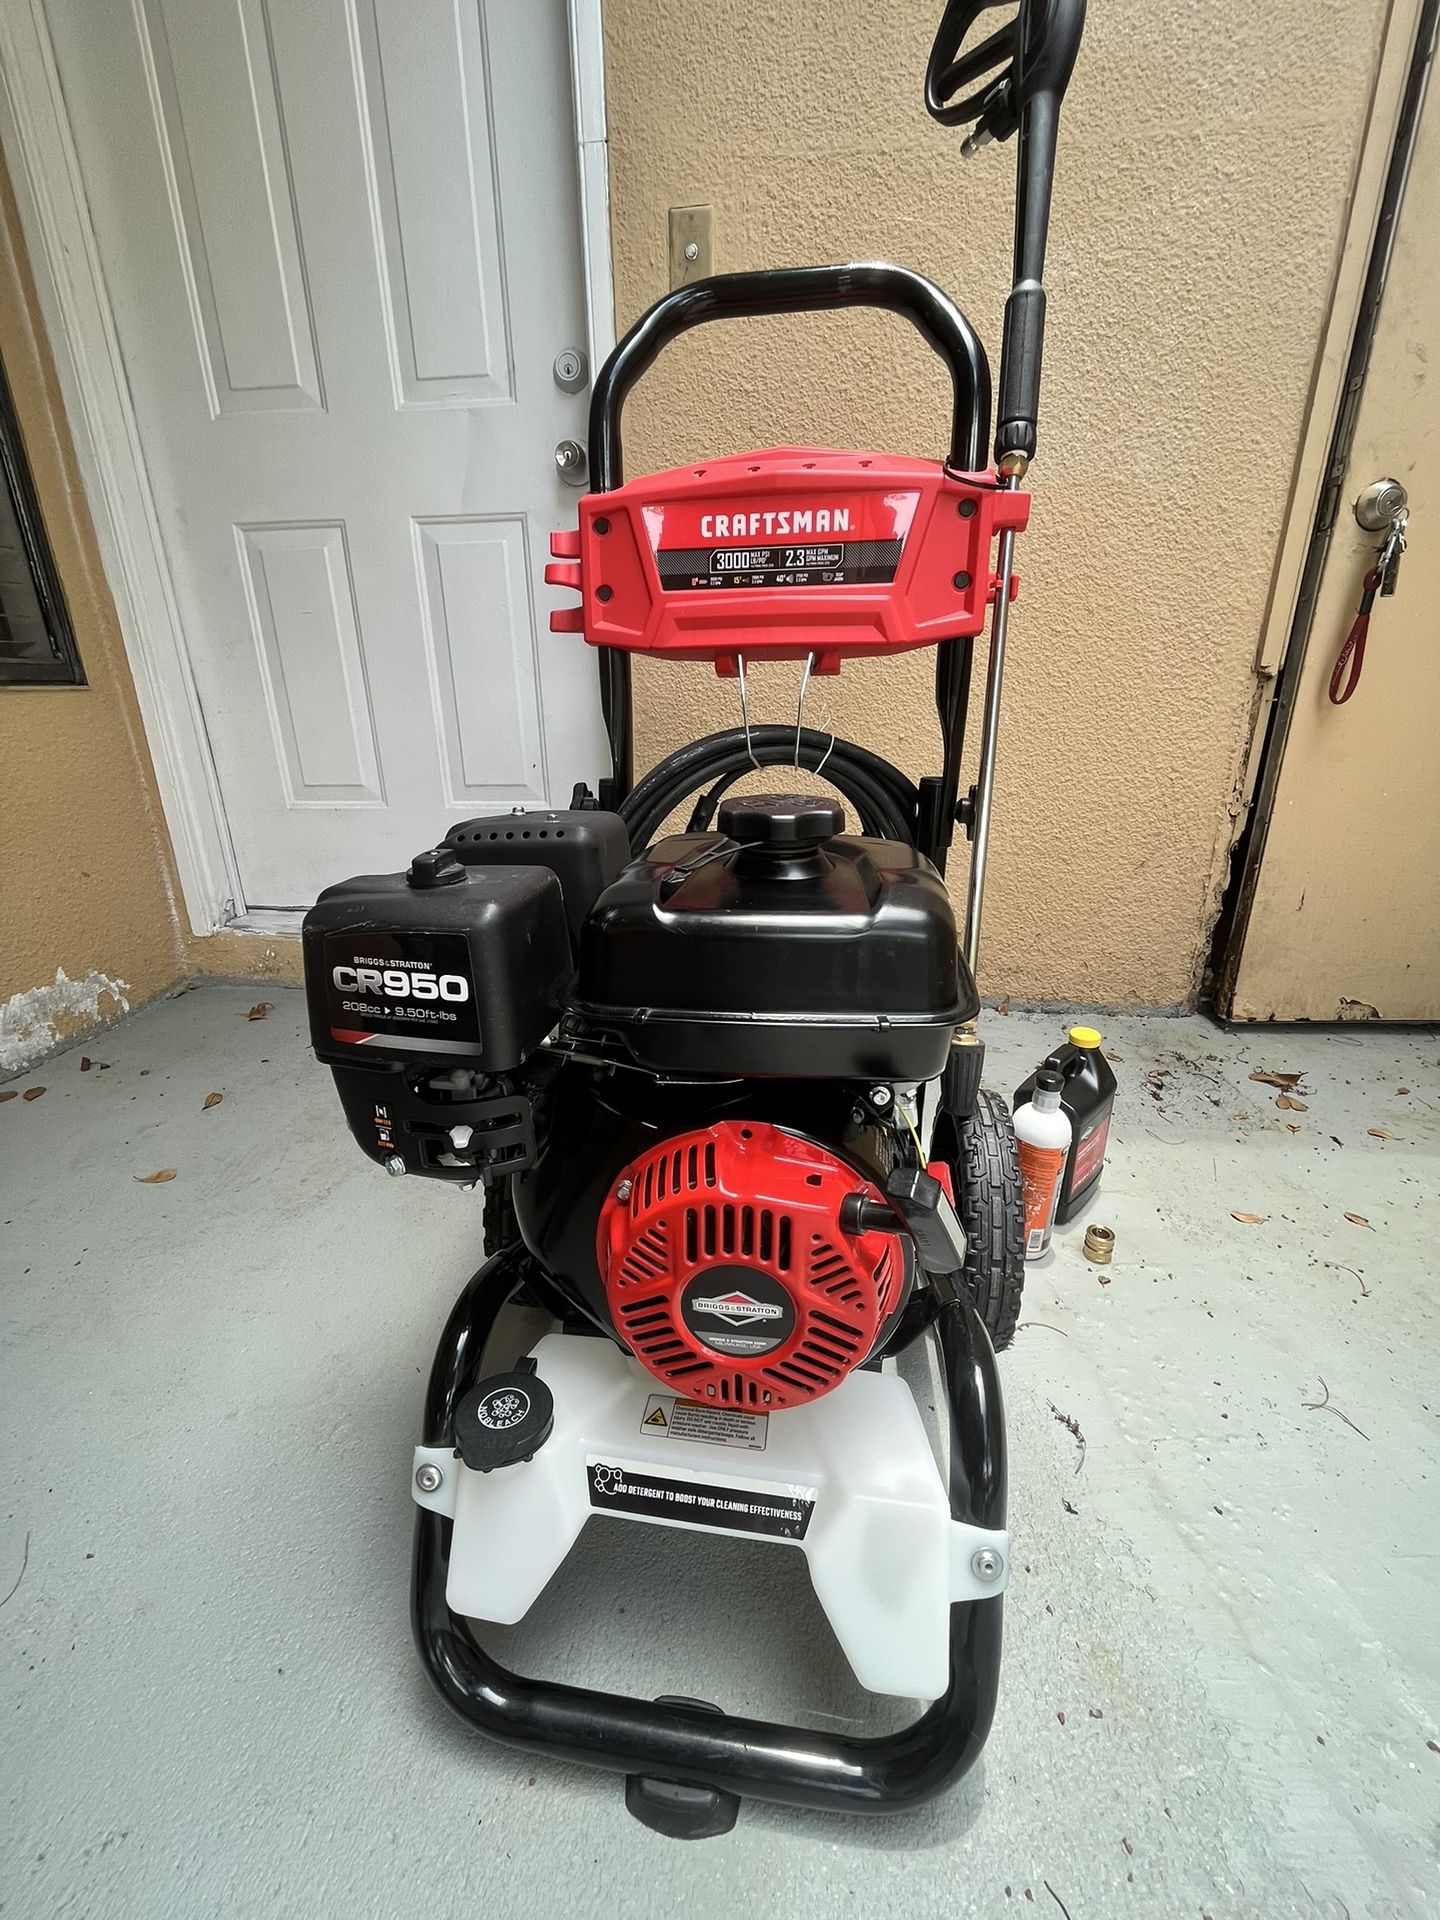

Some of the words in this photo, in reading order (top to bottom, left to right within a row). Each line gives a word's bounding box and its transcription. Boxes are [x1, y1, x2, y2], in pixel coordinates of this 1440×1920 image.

[701, 509, 849, 538] CRAFTSMAN
[717, 552, 749, 569] 3000
[786, 549, 805, 567] 2.3
[333, 966, 469, 1002] CR950
[342, 1001, 381, 1014] 208cc
[395, 1006, 457, 1020] 9.50ft-lbs
[613, 1483, 627, 1493] ADD
[628, 1485, 665, 1499] DETERGENT
[666, 1491, 674, 1501] TO
[675, 1493, 697, 1504] BOOST
[697, 1497, 715, 1508] YOUR
[716, 1499, 748, 1512] CLEANING
[749, 1505, 802, 1521] EFFECTIVENESS
